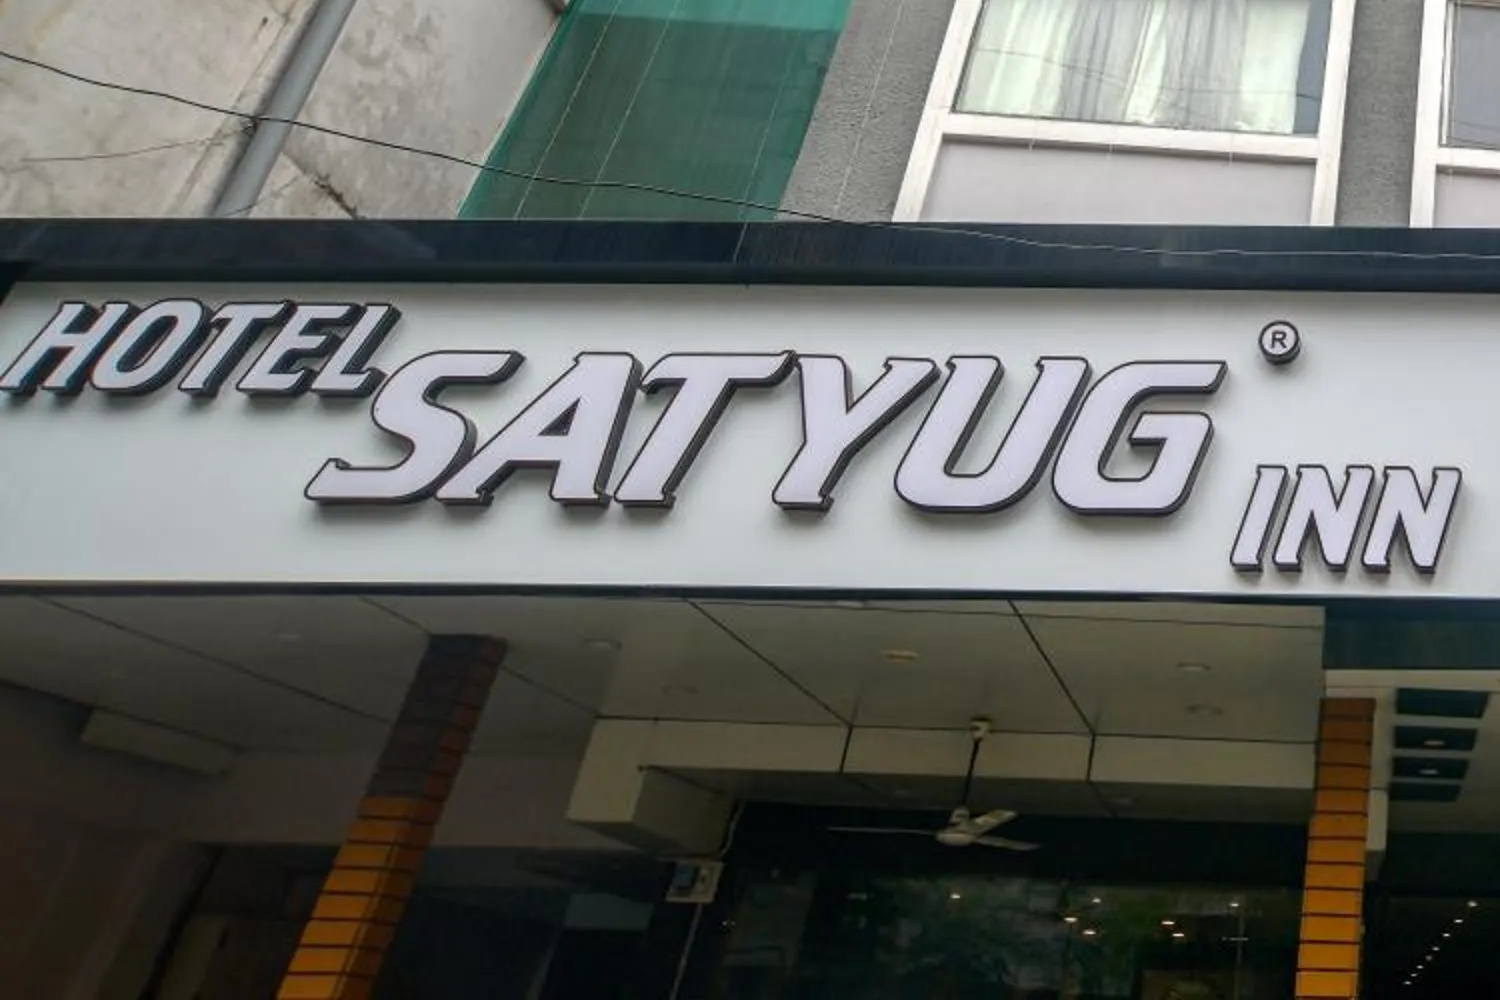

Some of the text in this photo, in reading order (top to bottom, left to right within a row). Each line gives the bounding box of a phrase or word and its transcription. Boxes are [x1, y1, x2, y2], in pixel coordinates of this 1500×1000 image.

[0, 298, 402, 396] HOTEL
[304, 350, 1229, 516] SATYUG
[1229, 464, 1463, 574] INN
